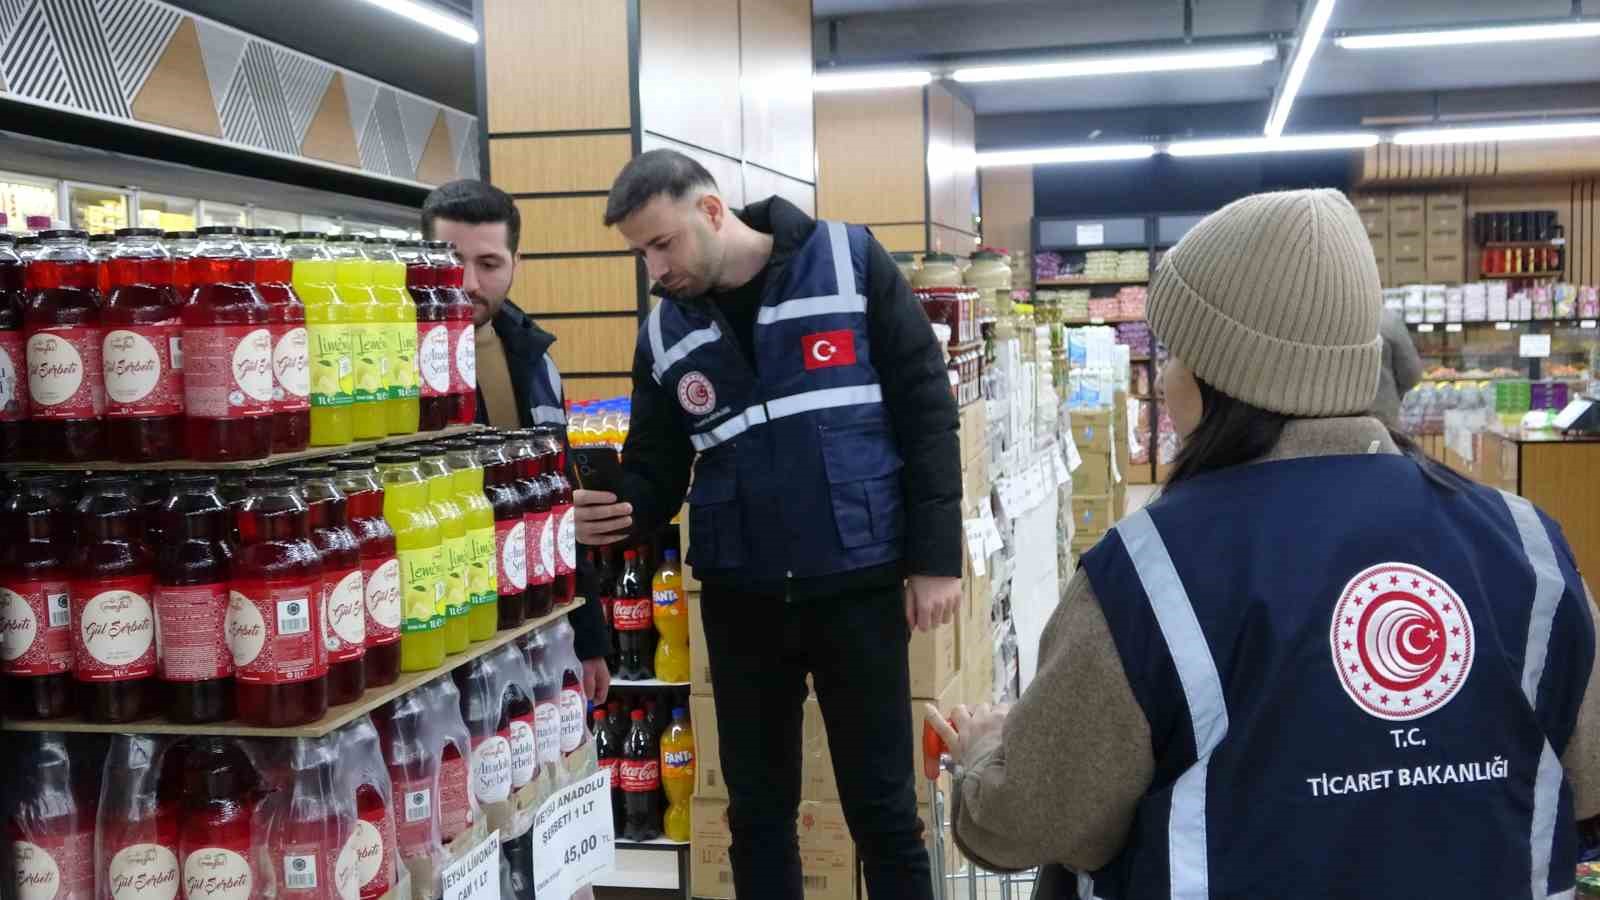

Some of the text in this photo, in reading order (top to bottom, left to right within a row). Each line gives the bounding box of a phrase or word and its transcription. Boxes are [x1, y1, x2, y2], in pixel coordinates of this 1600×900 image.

[86, 621, 108, 643] Gül
[1390, 727, 1426, 748] T.C.
[1307, 755, 1508, 797] TİCARET BAKANLIĞI
[557, 776, 605, 810] ANADOLU
[583, 800, 595, 815] LT
[564, 834, 597, 865] 45,00
